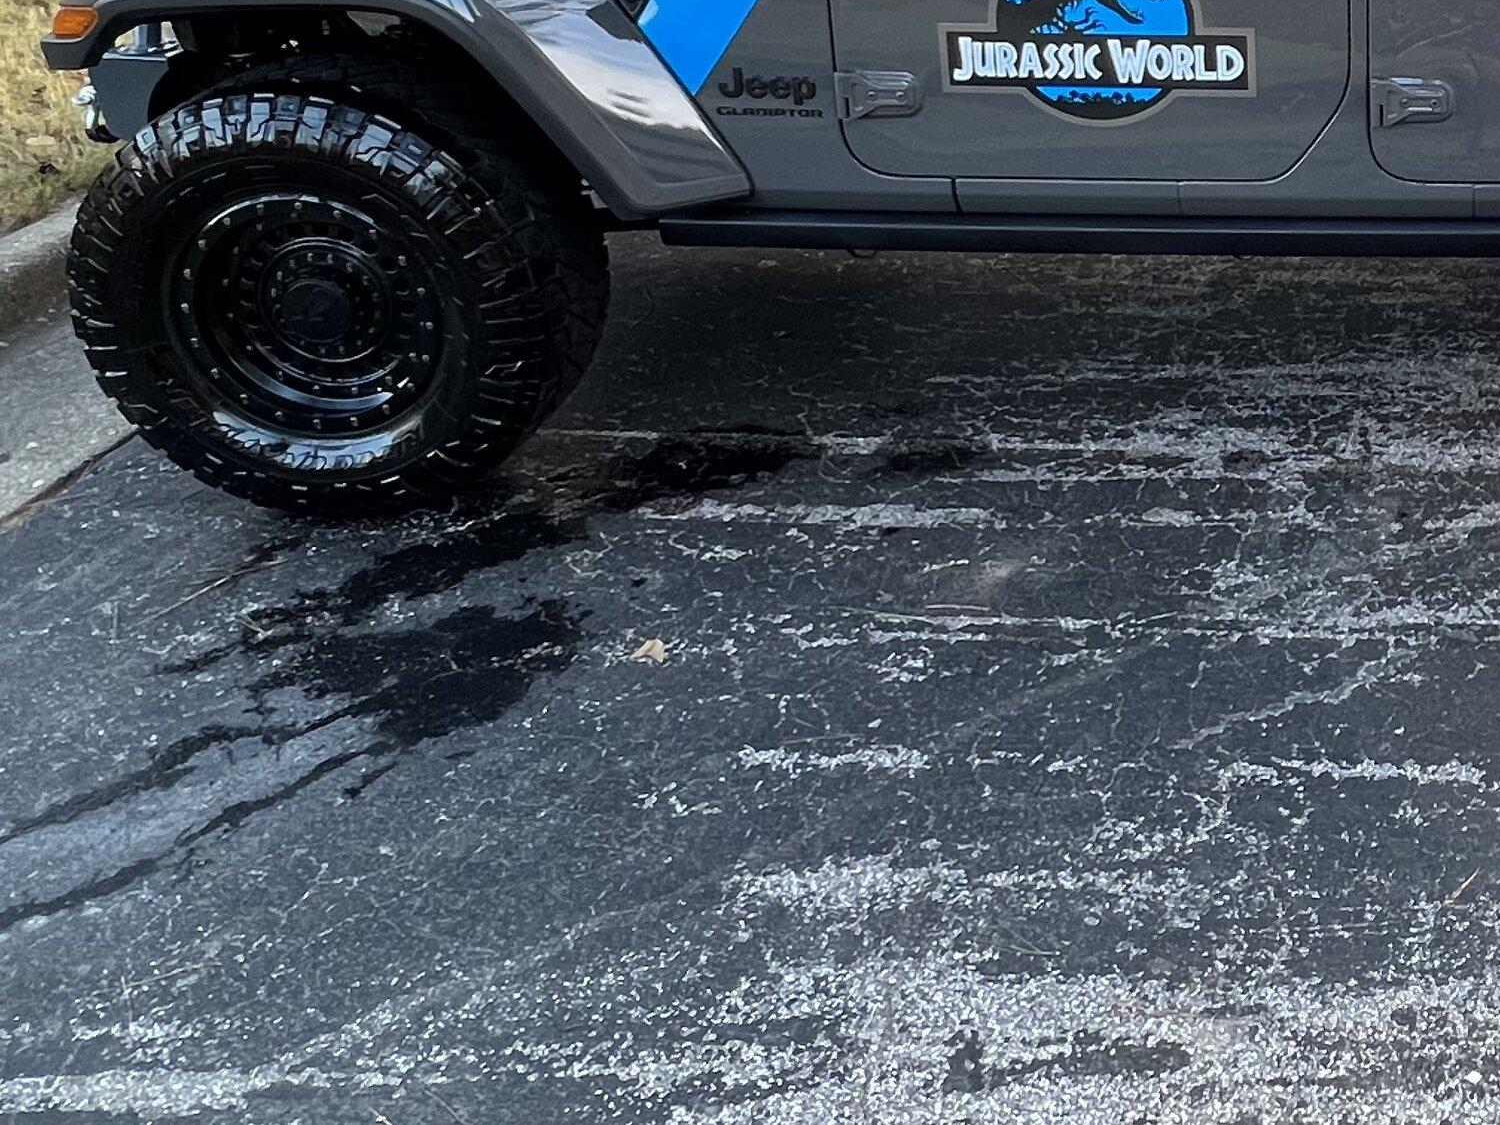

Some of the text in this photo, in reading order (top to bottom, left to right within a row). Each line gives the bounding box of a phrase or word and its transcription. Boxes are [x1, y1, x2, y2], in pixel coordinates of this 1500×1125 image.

[952, 36, 1245, 85] JURASSIC WORLD
[718, 67, 817, 106] Jeep
